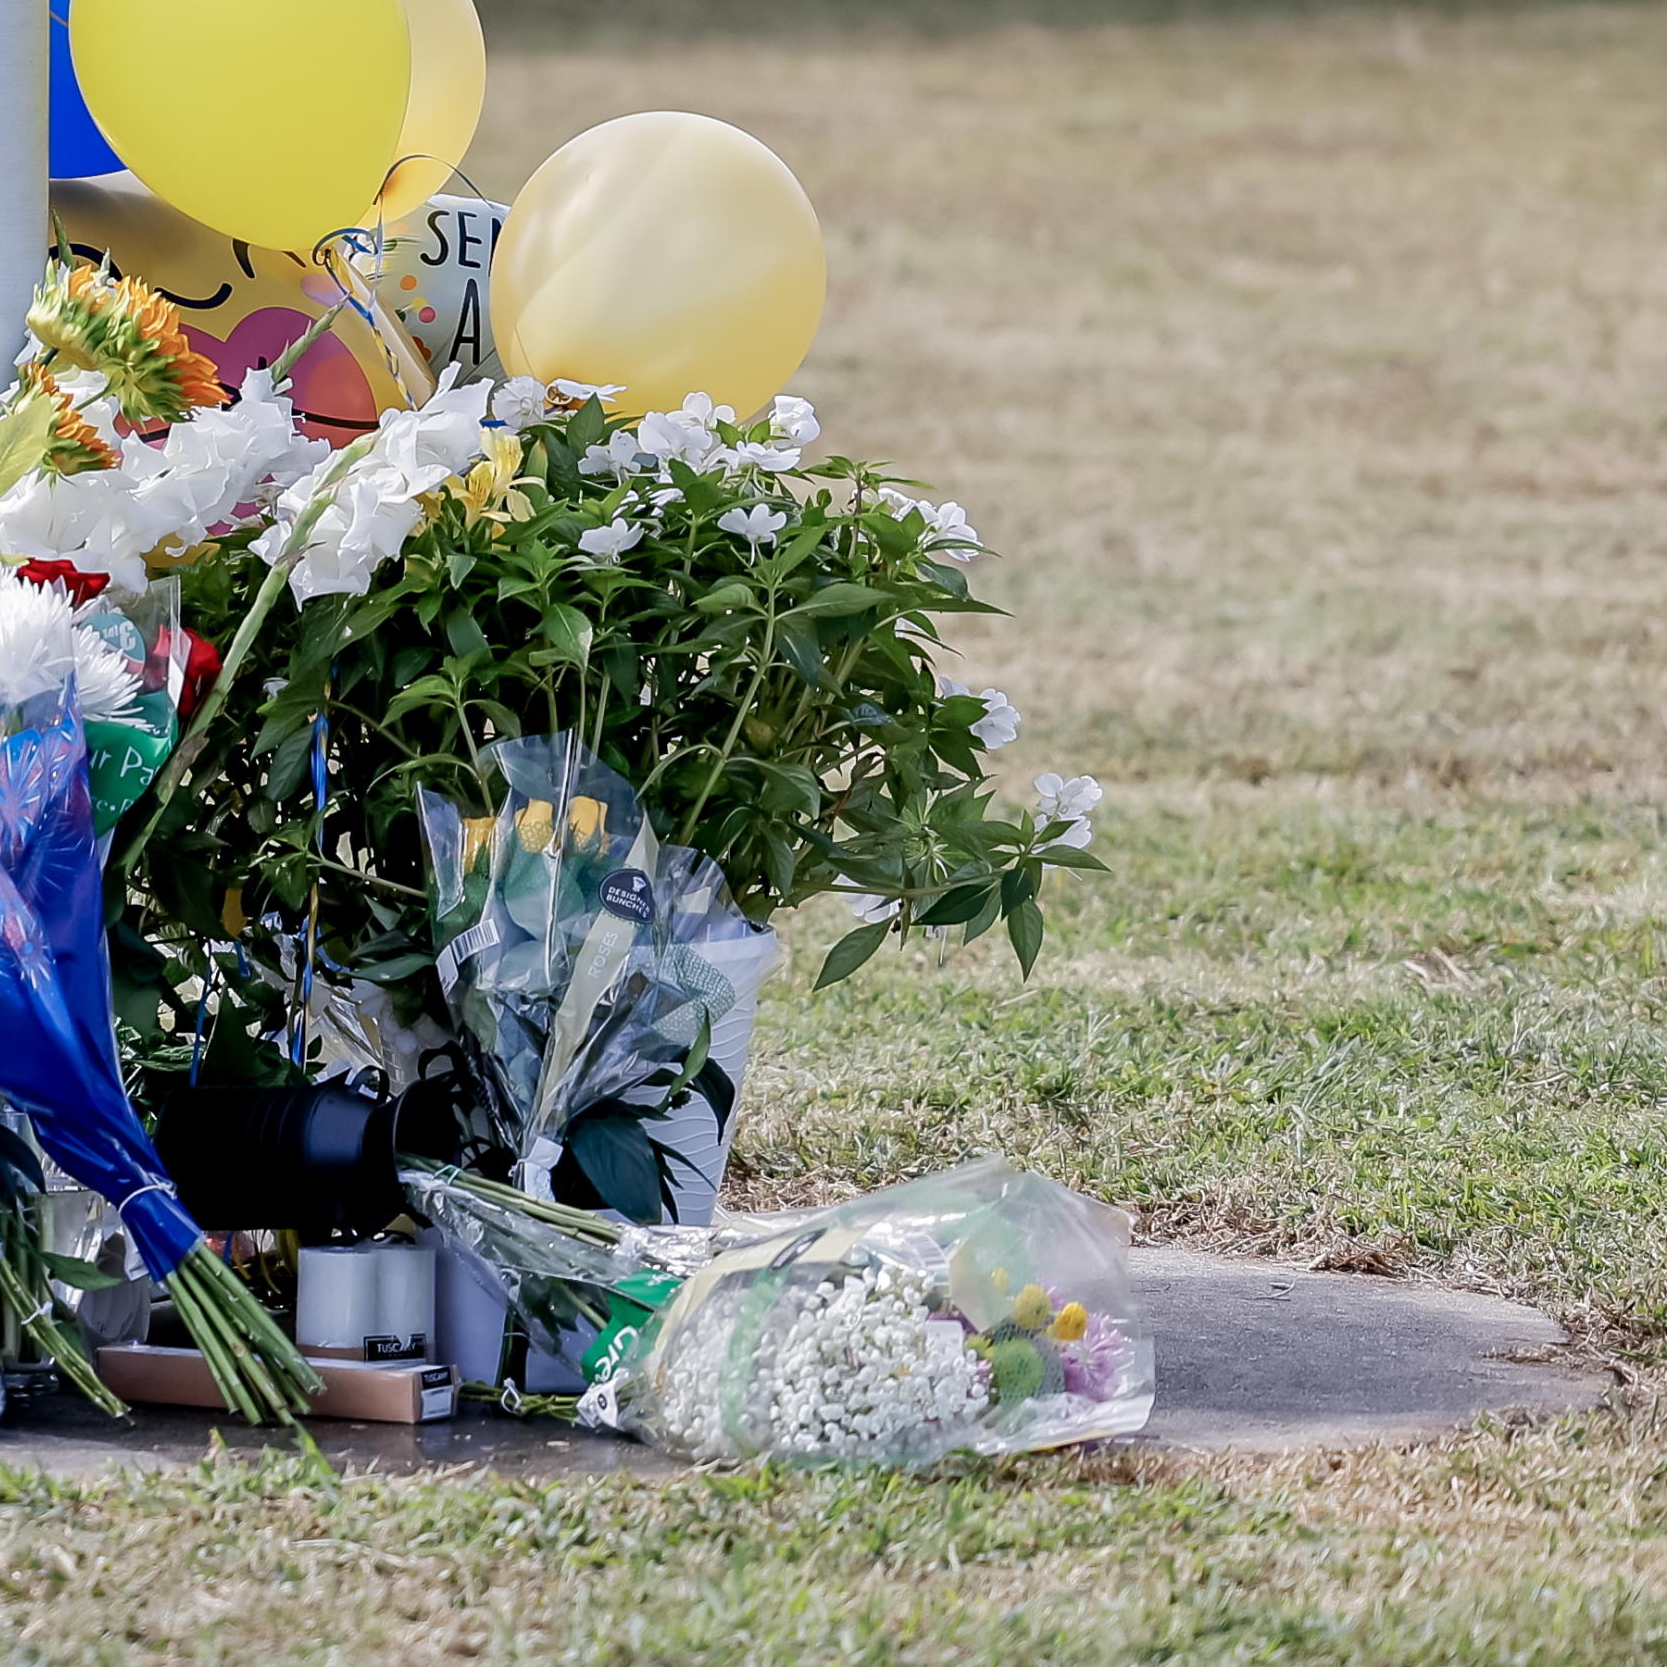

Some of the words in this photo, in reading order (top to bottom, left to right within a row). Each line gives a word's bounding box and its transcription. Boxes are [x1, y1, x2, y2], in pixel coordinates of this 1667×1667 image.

[449, 278, 480, 366] A
[587, 931, 618, 979] ROSES
[377, 1342, 416, 1354] TUSCY
